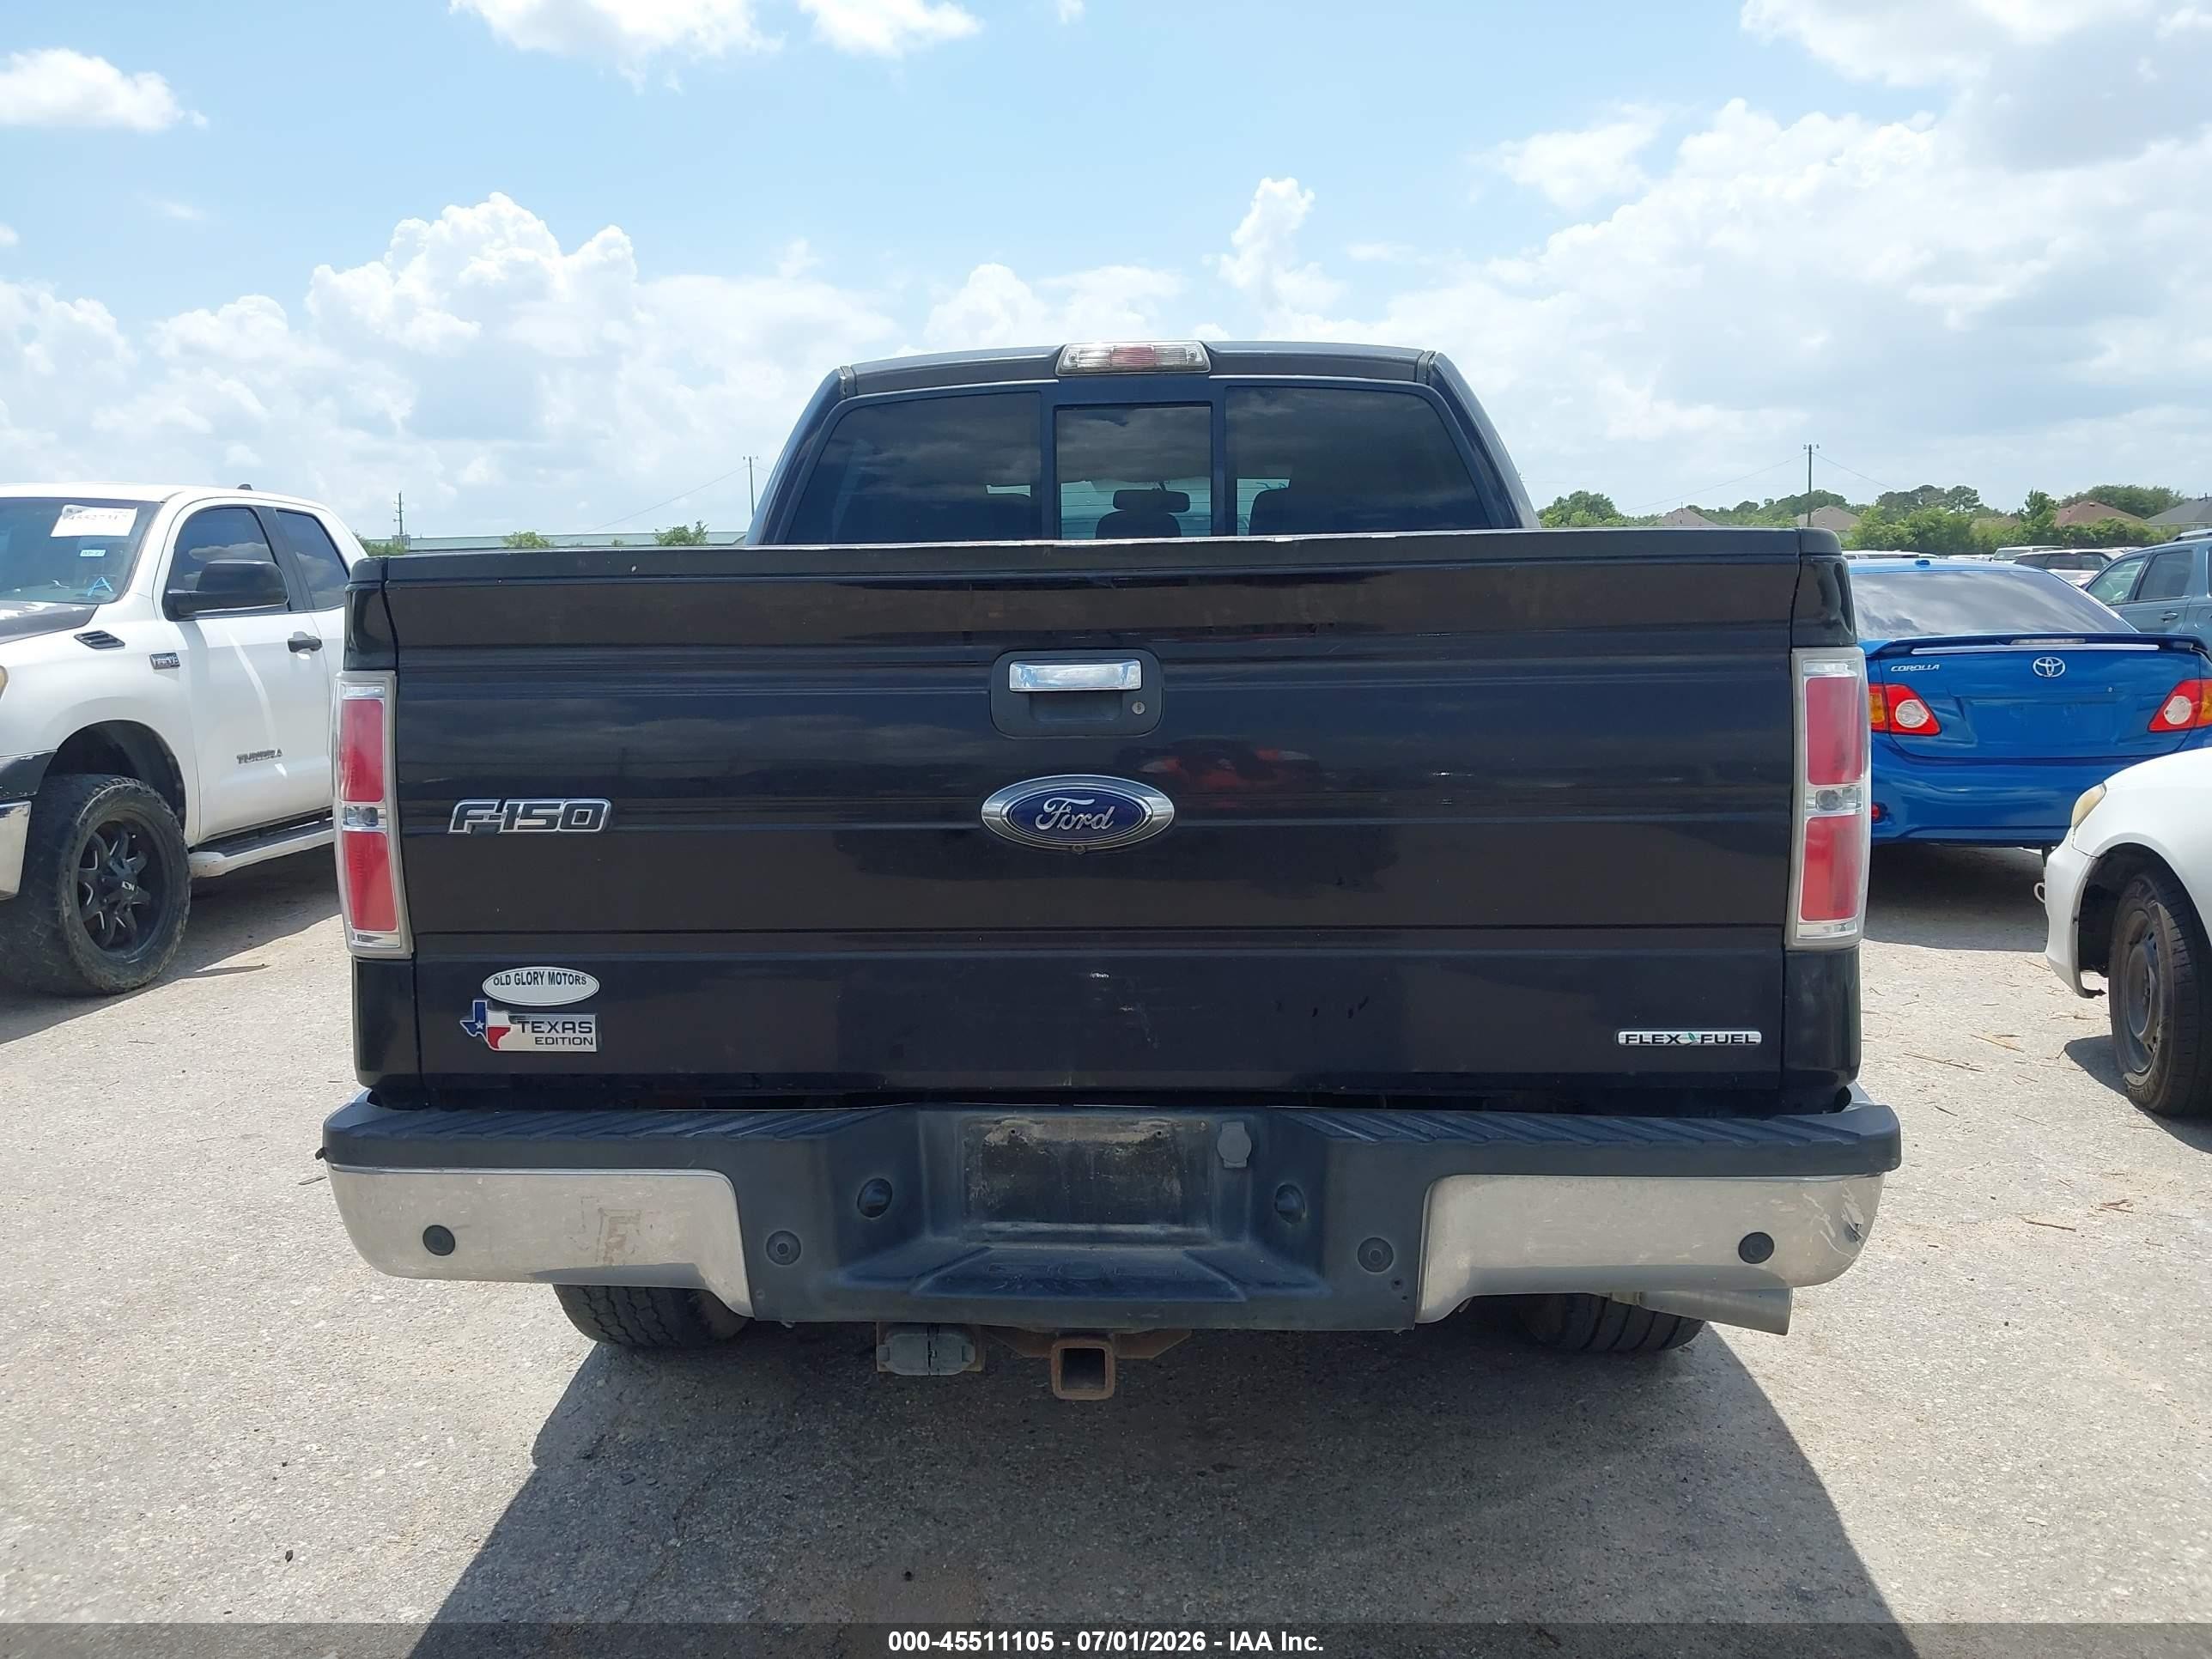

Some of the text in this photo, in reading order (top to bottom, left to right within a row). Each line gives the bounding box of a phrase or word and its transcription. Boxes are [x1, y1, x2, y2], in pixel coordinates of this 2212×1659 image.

[1890, 664, 1940, 672] COROLLA
[447, 799, 611, 834] F-150
[1036, 797, 1115, 830] Ford
[493, 971, 587, 986] OLD GLORY MOTORS
[517, 1020, 592, 1034] TEXAS
[535, 1036, 593, 1046] EDITION
[1625, 1034, 1757, 1045] FLEX FUEL
